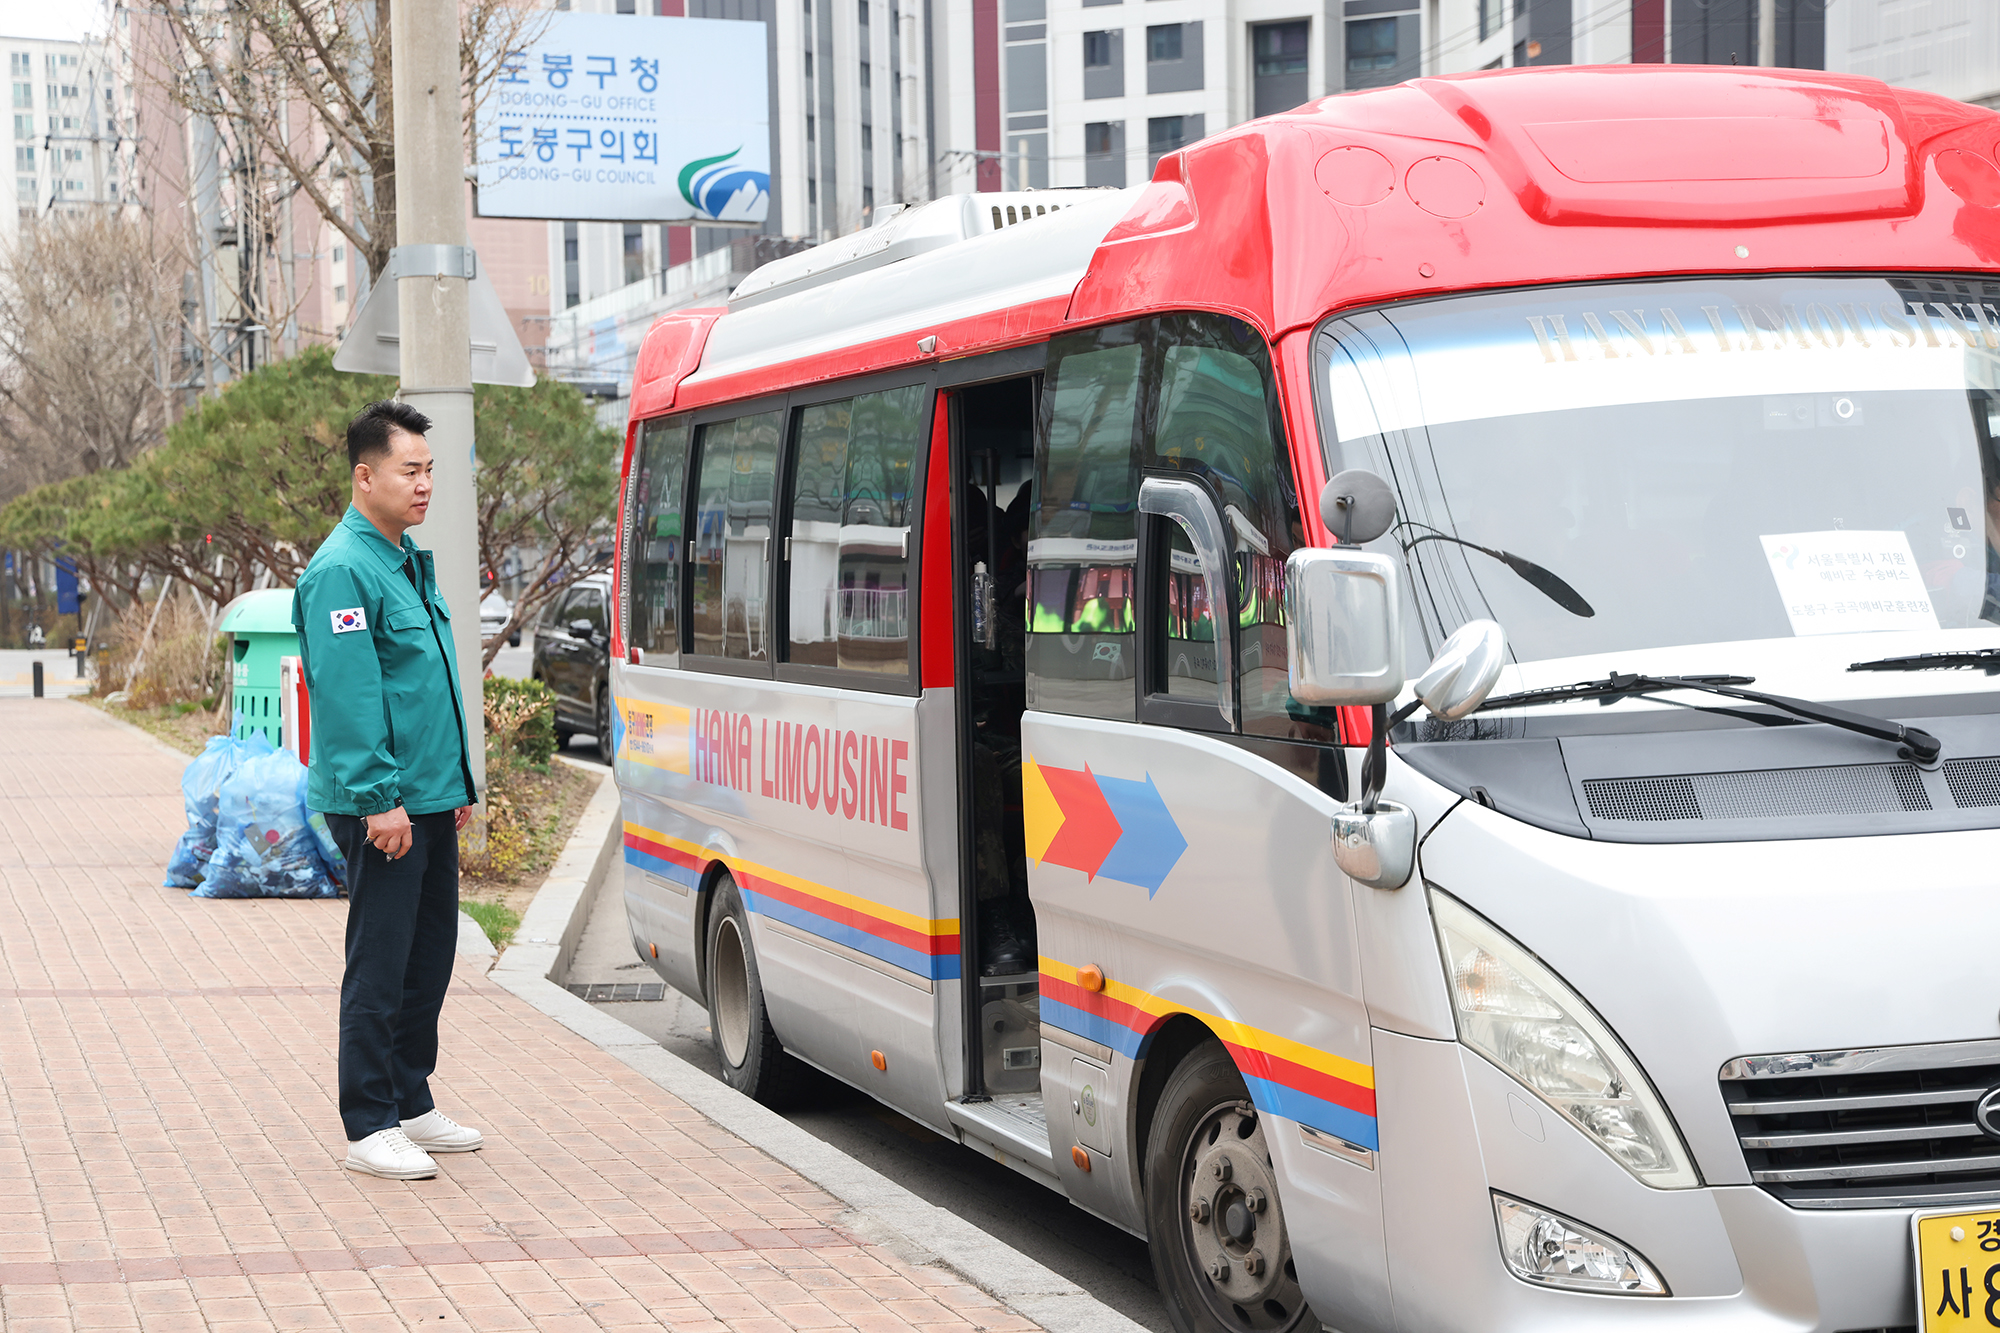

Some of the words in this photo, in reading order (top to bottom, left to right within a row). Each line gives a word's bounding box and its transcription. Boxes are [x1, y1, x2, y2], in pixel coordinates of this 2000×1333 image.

[498, 51, 659, 93] 도봉구청
[499, 92, 602, 109] DOBONG-GU
[607, 96, 656, 112] OFFICE
[498, 126, 659, 165] 도봉구의회
[499, 165, 592, 183] DOBONG-GU
[596, 169, 656, 185] COUNCIL
[1525, 307, 1698, 364] HANA
[1807, 552, 1874, 567] 서울특별시
[1879, 552, 1907, 566] 지원
[1820, 569, 1857, 582] 예비군
[1863, 568, 1910, 581] 수송버스
[696, 707, 752, 793] HANA
[761, 718, 909, 832] LIMOUSINE
